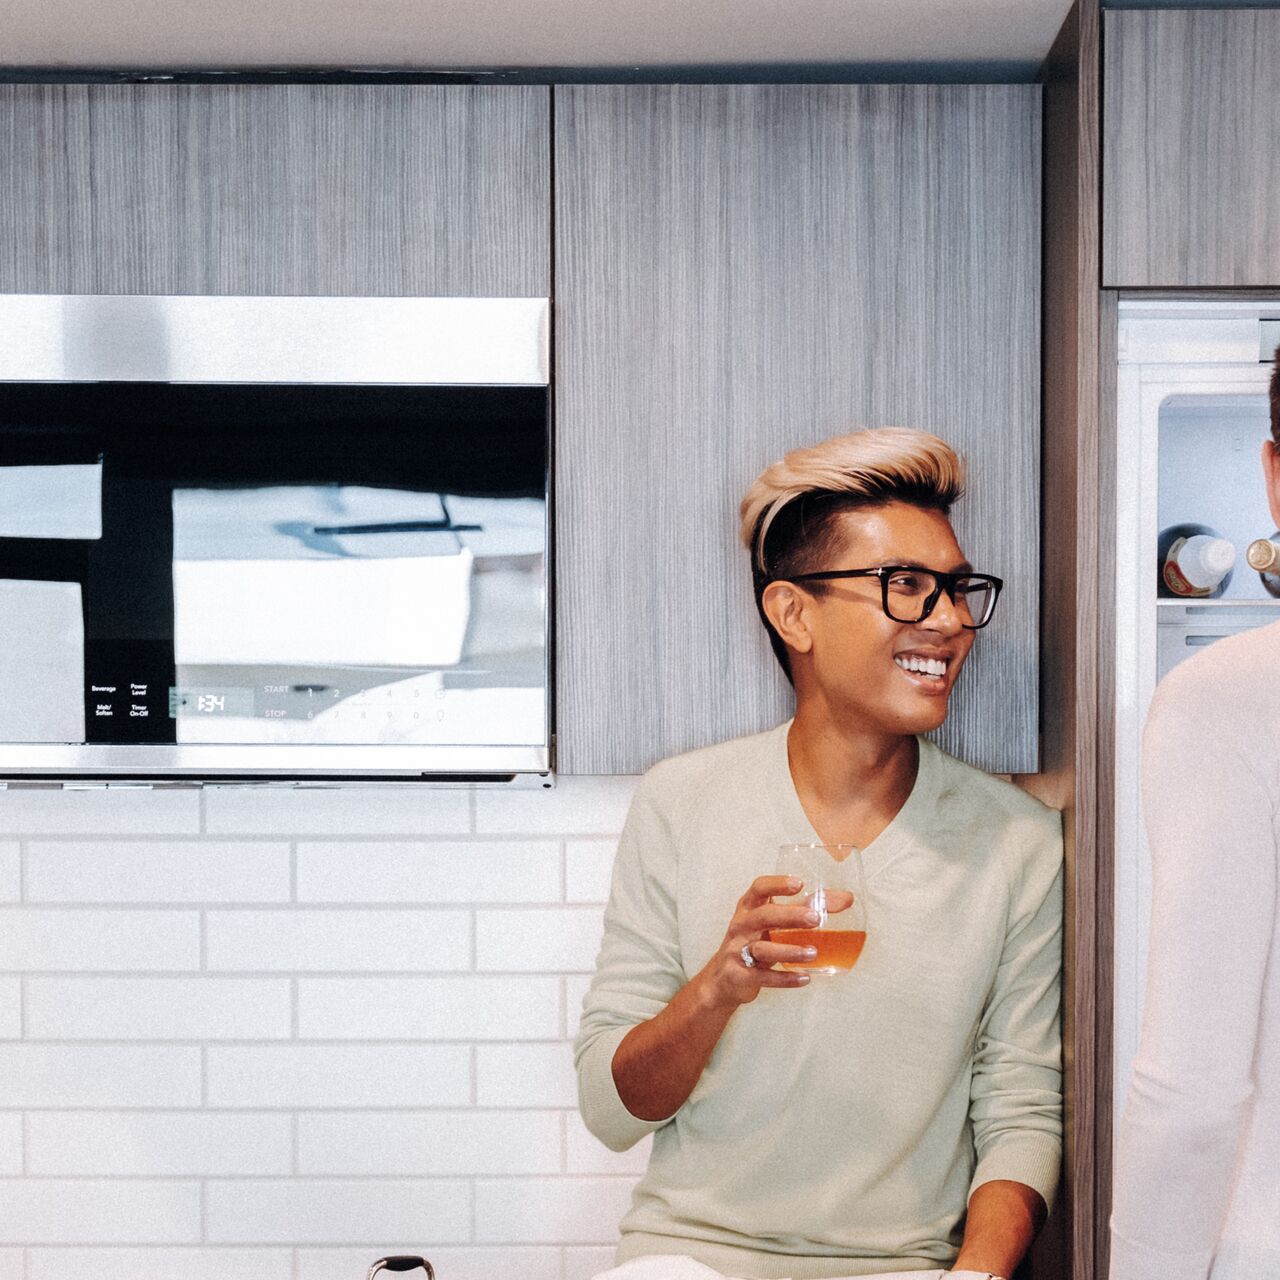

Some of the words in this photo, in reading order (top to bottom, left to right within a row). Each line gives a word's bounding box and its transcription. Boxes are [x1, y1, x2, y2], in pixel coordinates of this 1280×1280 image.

[263, 685, 289, 694] START
[333, 688, 340, 698] 2
[264, 709, 287, 718] STOP
[306, 710, 314, 719] 6
